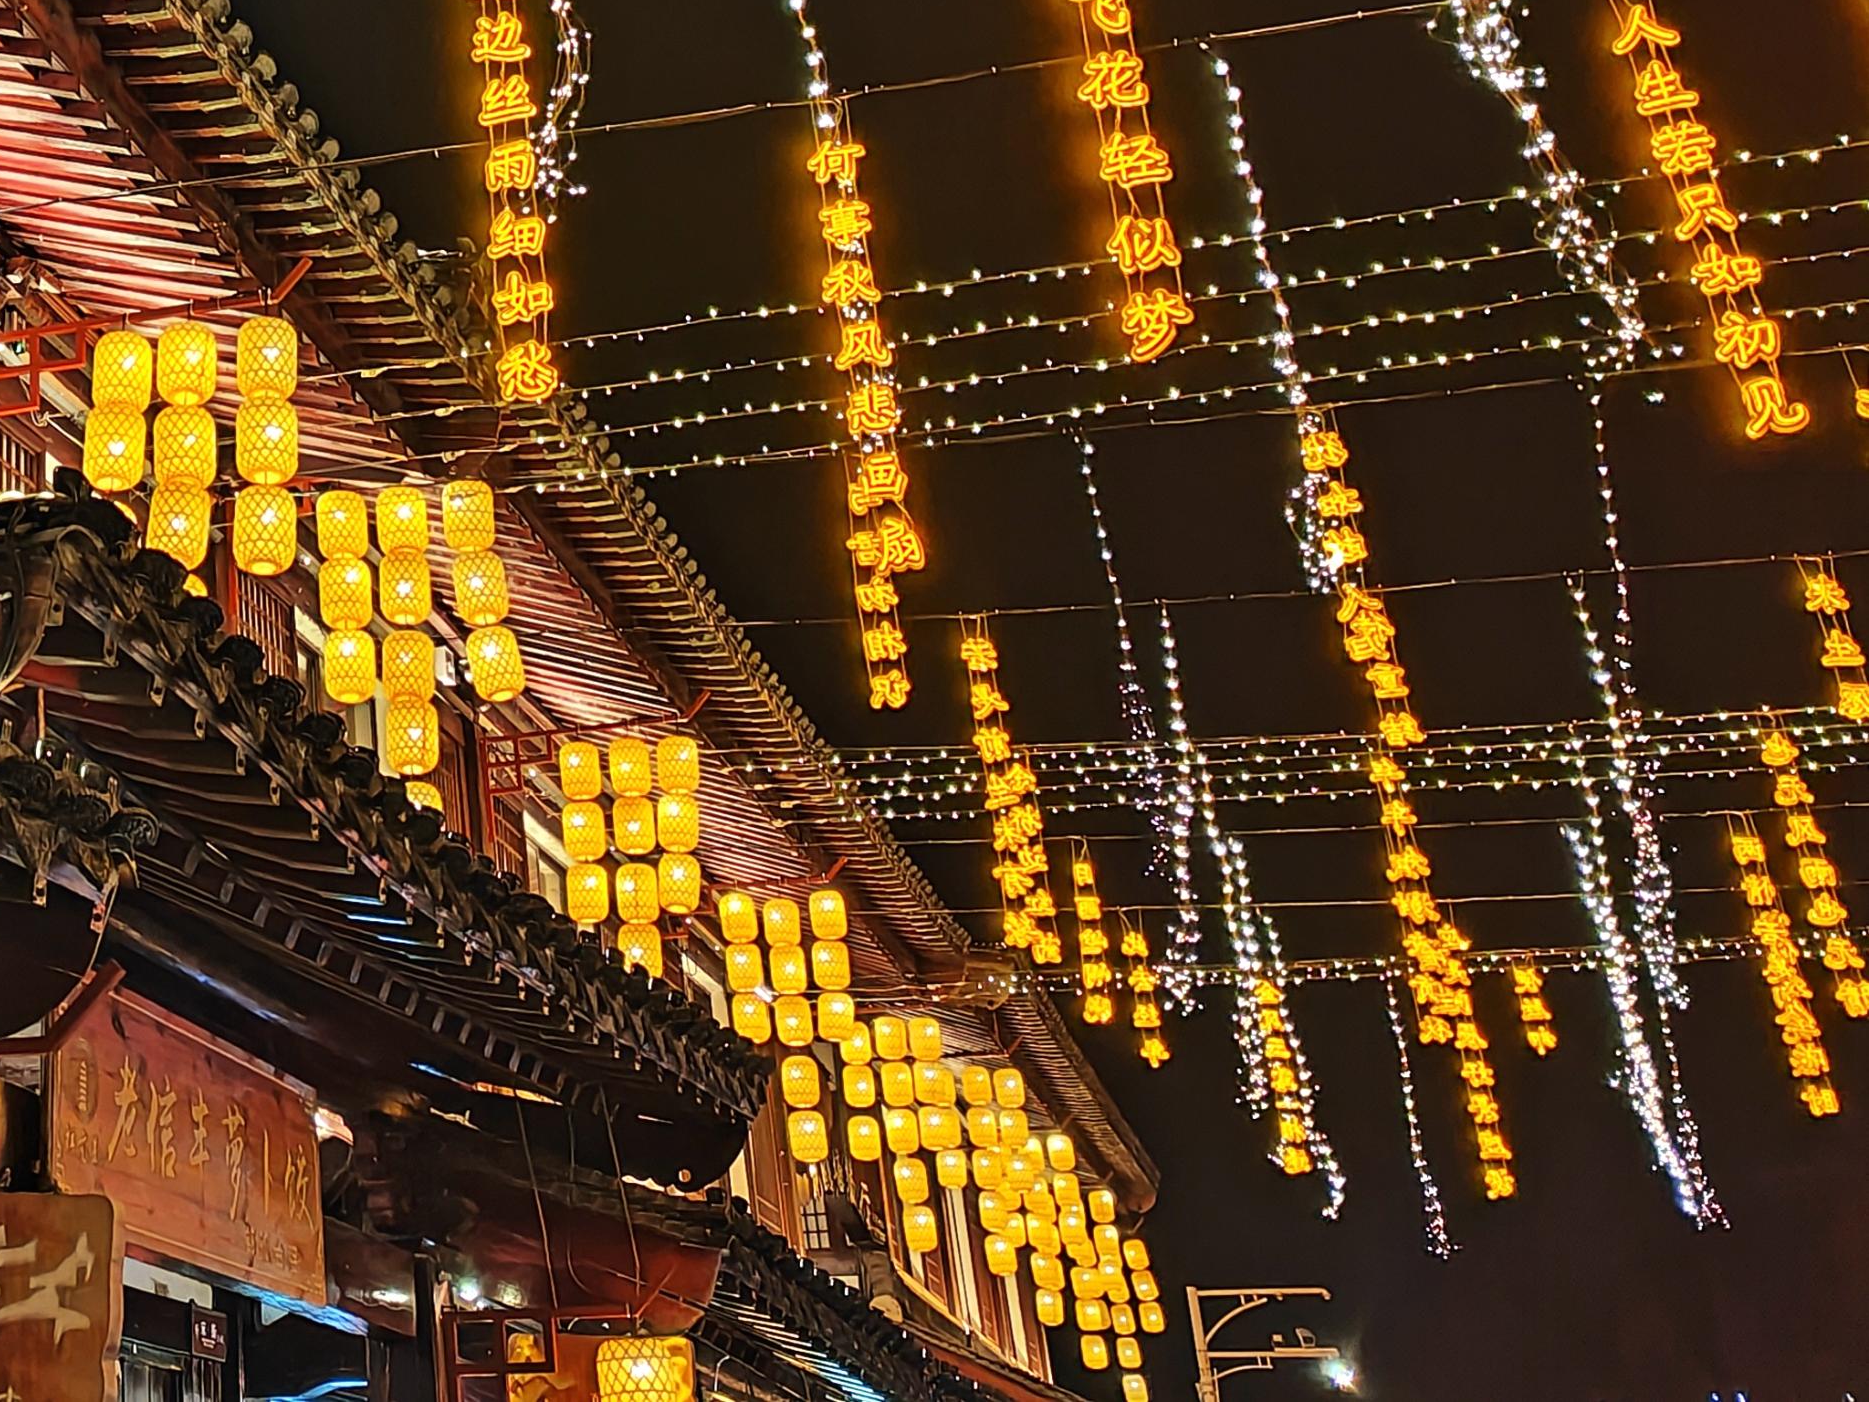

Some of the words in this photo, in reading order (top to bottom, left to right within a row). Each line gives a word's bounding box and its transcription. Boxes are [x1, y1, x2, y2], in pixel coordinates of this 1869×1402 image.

[807, 138, 927, 574] 何事秋风悲画扇
[1612, 4, 1810, 439] 人生若只如初见
